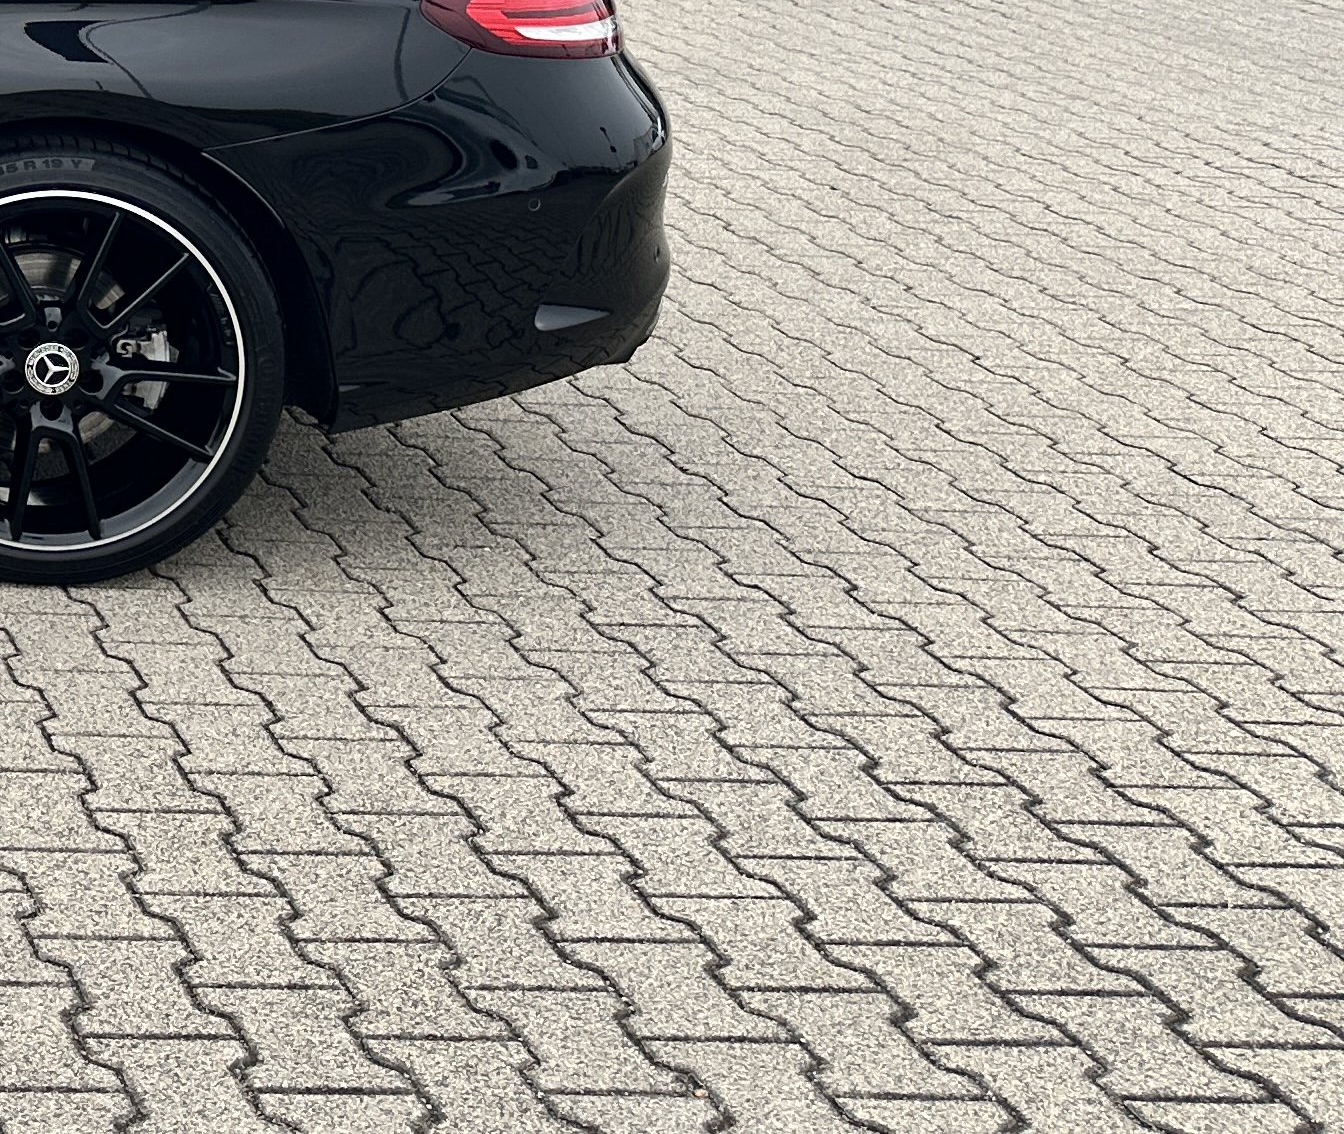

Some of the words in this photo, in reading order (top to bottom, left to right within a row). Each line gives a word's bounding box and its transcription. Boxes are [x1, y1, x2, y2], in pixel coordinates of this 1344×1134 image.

[23, 160, 37, 170] R
[42, 158, 63, 169] 19
[70, 159, 82, 169] Y
